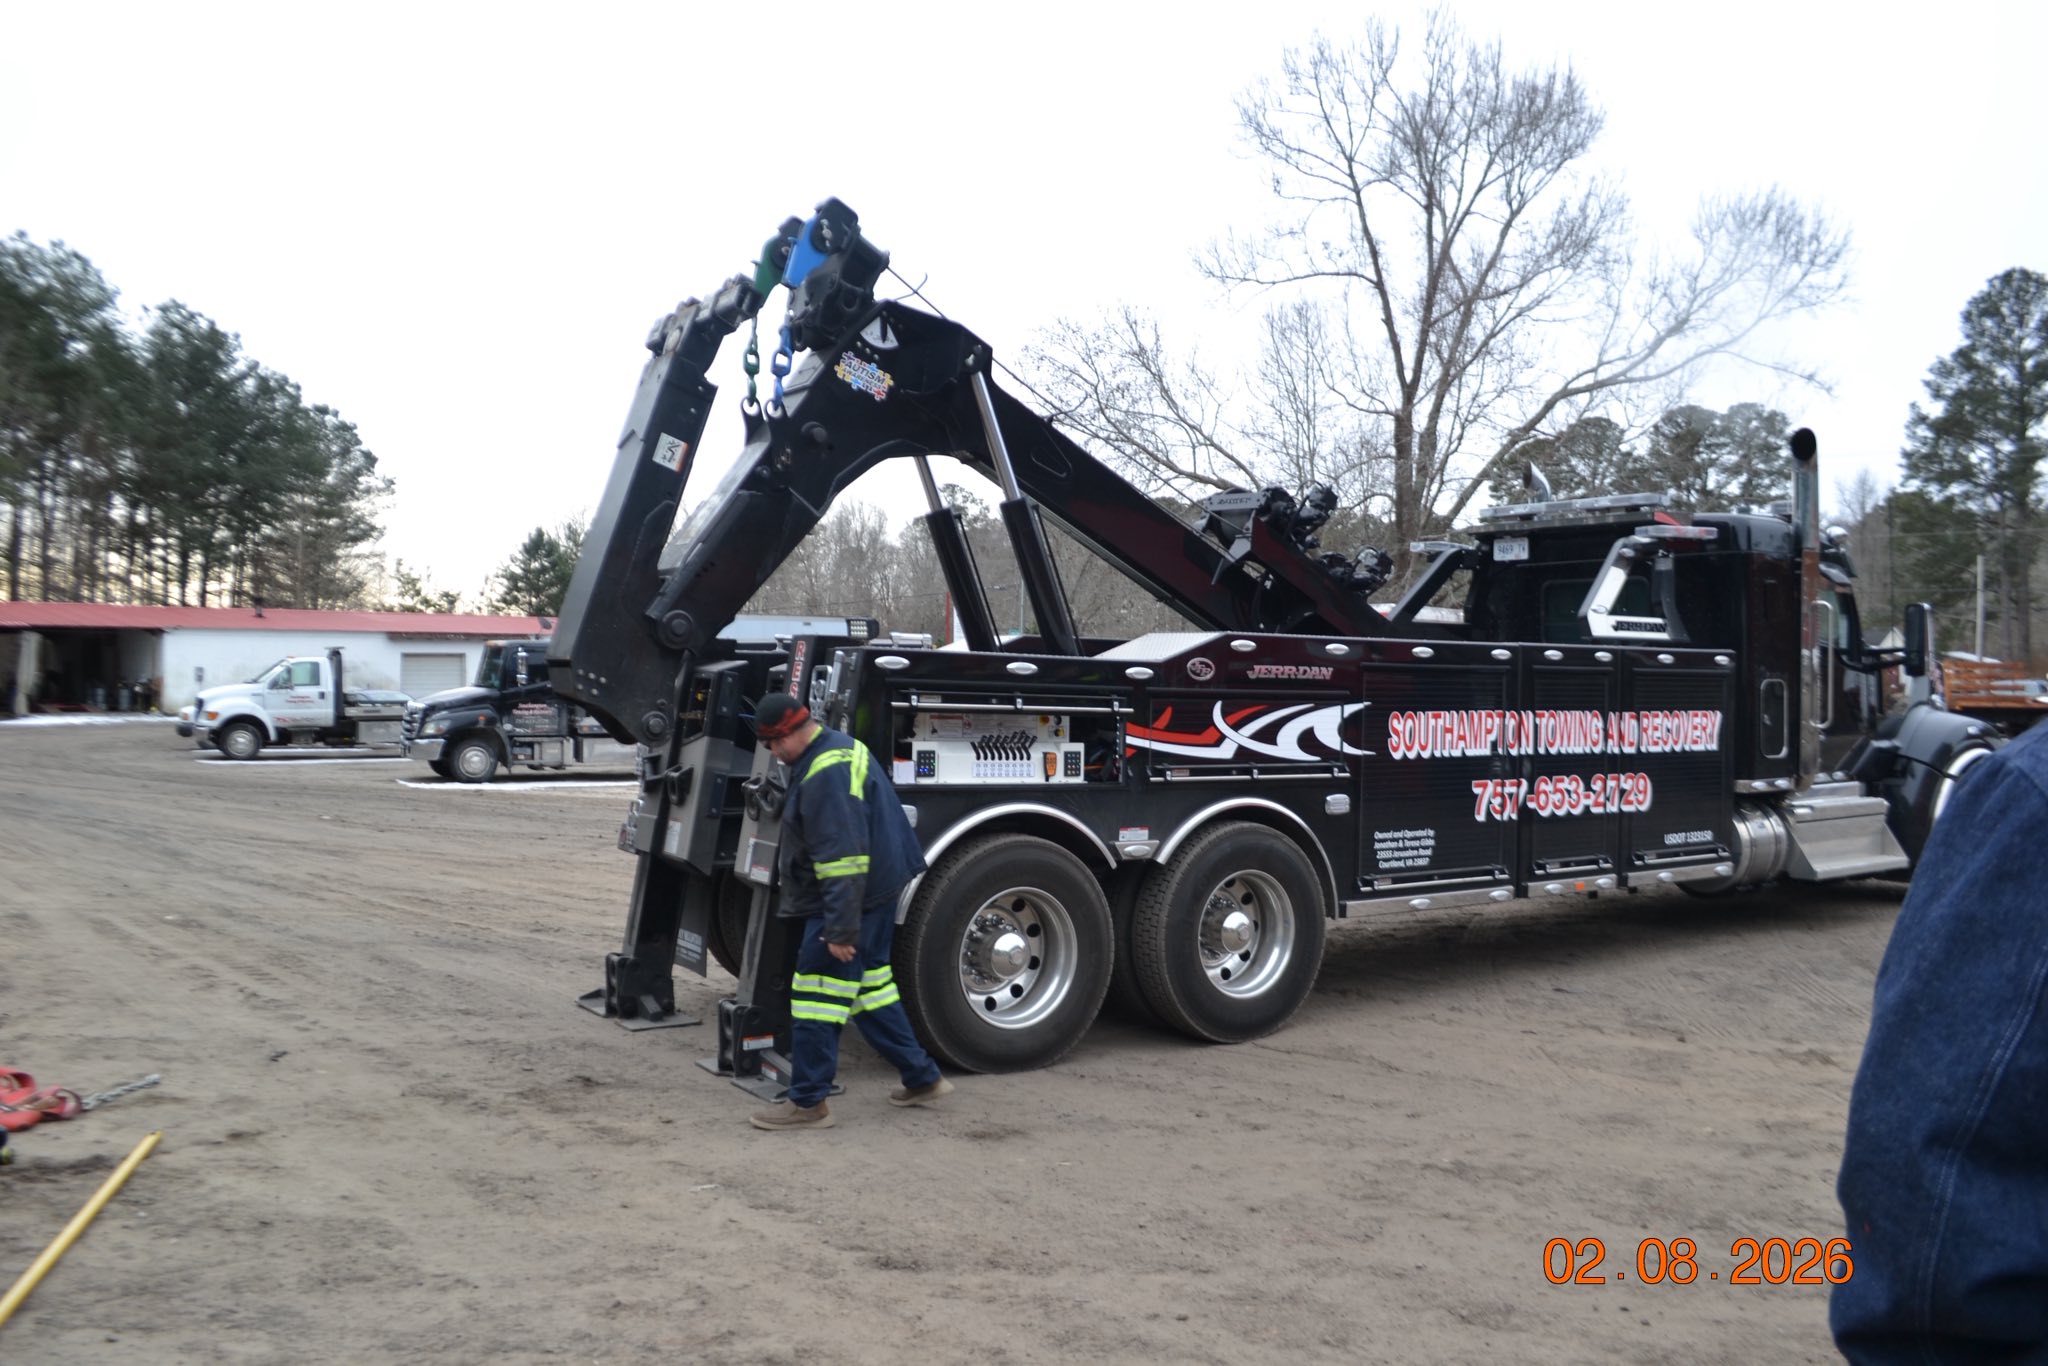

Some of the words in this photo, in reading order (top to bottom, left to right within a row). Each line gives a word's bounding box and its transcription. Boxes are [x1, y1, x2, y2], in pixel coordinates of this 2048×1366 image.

[845, 360, 886, 385] AUTISM
[1388, 710, 1535, 760] SOUTHAMPTON
[1535, 710, 1605, 755] TOWING
[1606, 711, 1638, 754] AND
[1639, 710, 1722, 752] RECOVERY
[1472, 772, 1652, 822] 757-653-2729
[1374, 830, 1393, 839] Owned
[1393, 830, 1404, 838] and
[1404, 829, 1427, 839] Operated
[1664, 832, 1686, 845] USDOT
[1373, 840, 1398, 849] Jonathan
